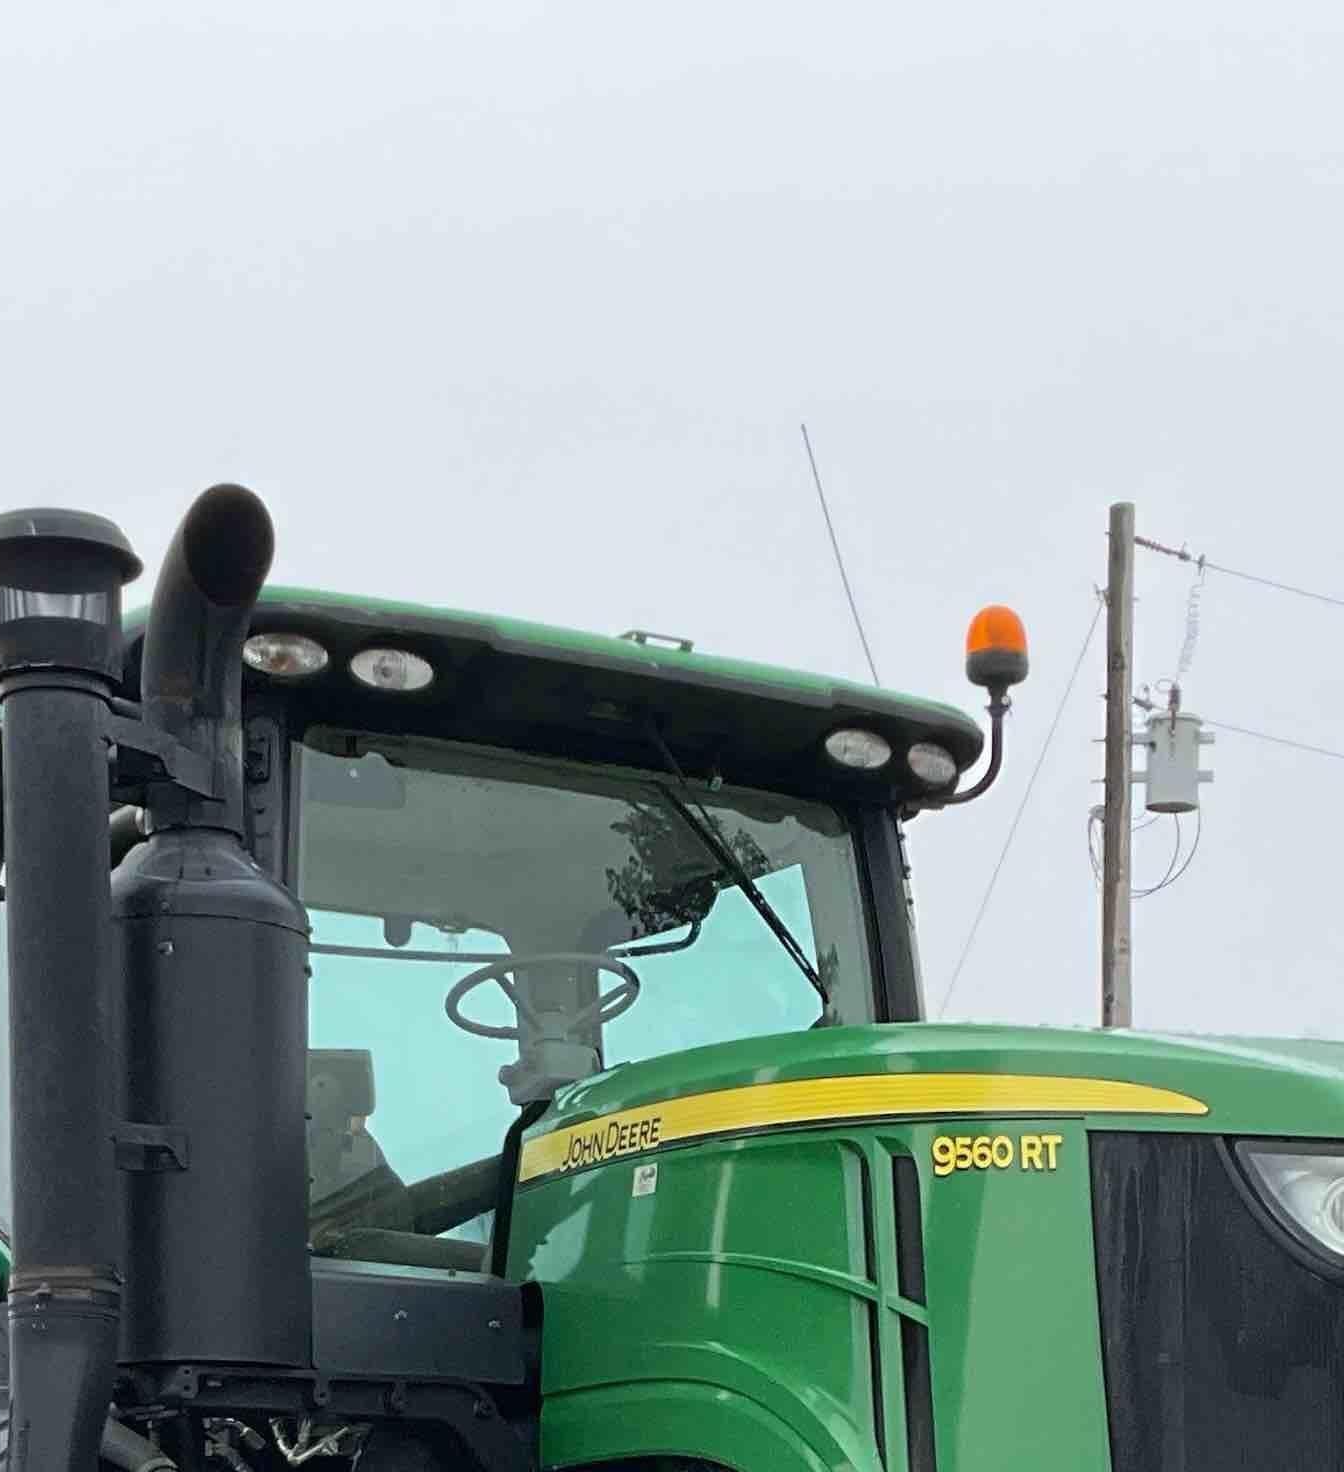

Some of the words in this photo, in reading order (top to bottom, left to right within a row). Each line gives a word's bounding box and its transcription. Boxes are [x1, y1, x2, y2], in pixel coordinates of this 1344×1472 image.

[561, 1130, 606, 1167] JOHN
[605, 1117, 662, 1154] DEERE
[932, 1135, 1014, 1176] 9560
[1019, 1134, 1063, 1170] RT
